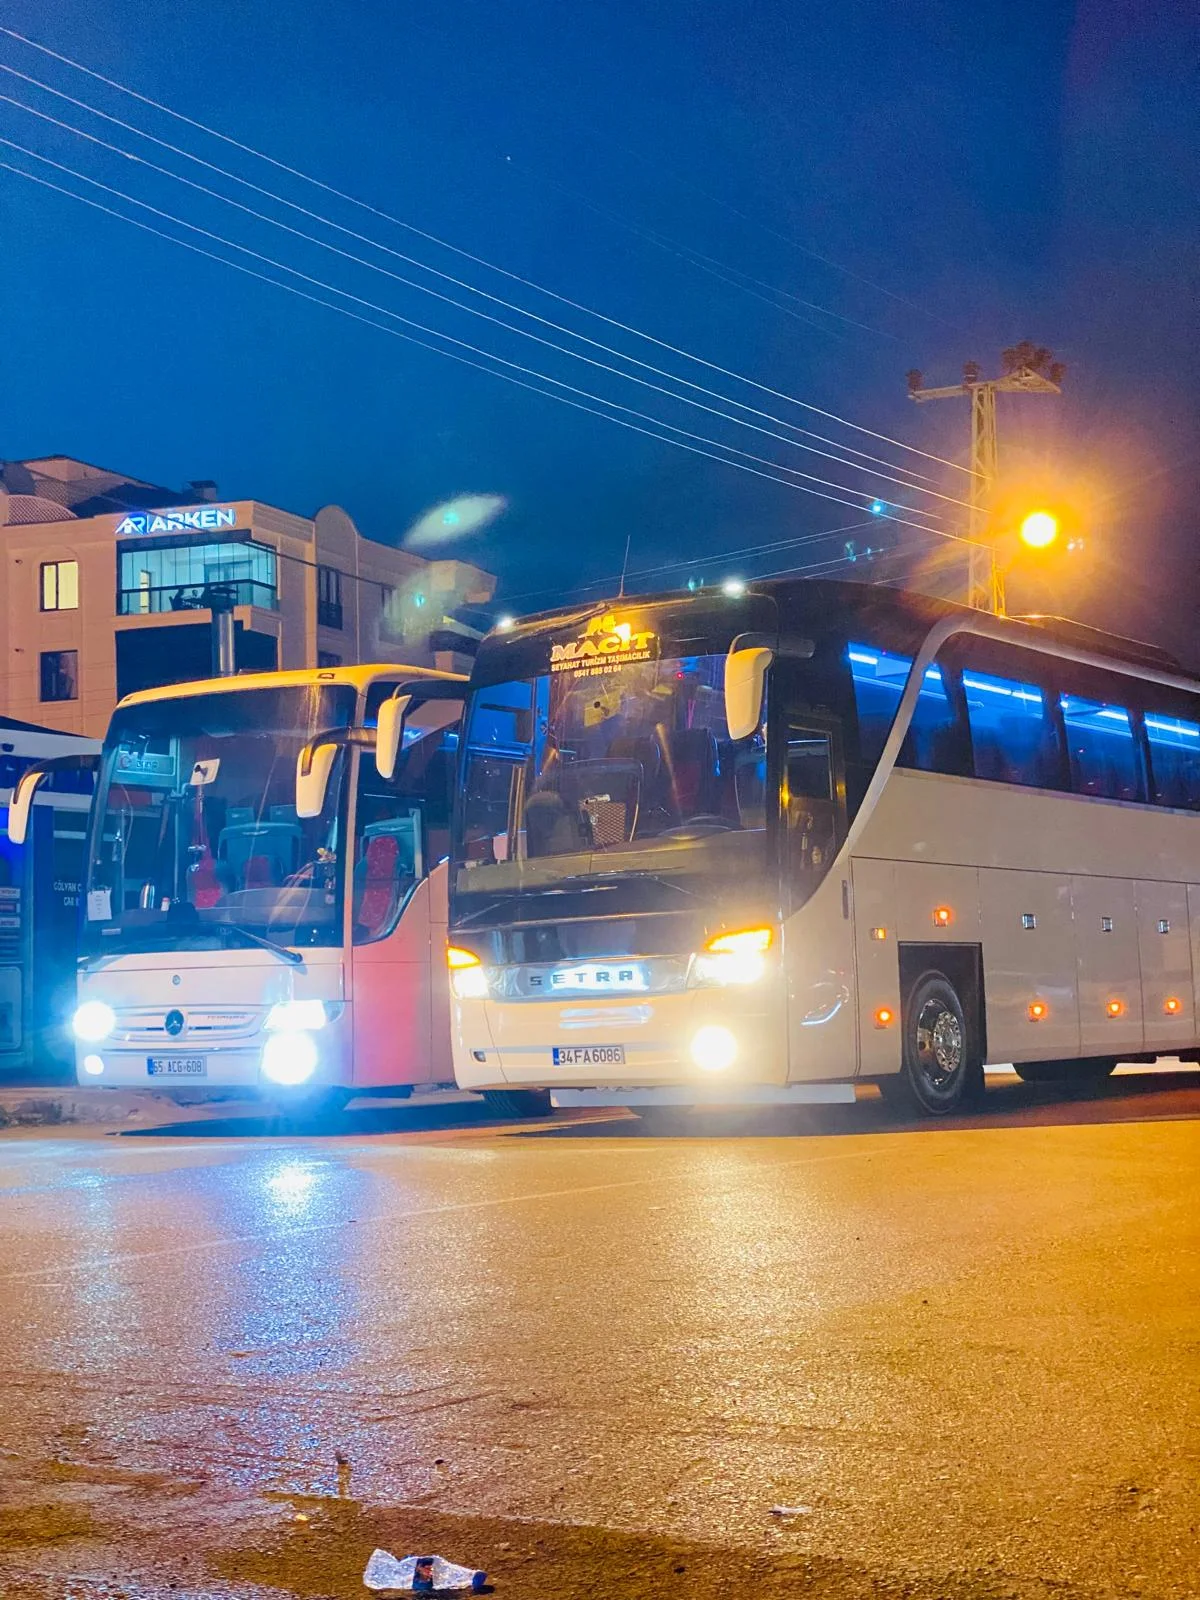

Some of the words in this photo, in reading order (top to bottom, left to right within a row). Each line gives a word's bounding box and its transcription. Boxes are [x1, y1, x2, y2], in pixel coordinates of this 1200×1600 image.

[149, 508, 234, 533] ARKEN
[551, 660, 581, 672] SEYAHAT
[581, 655, 607, 668] TURİZM
[607, 651, 651, 664] TAŞIMACILIK
[529, 970, 633, 986] SETRA
